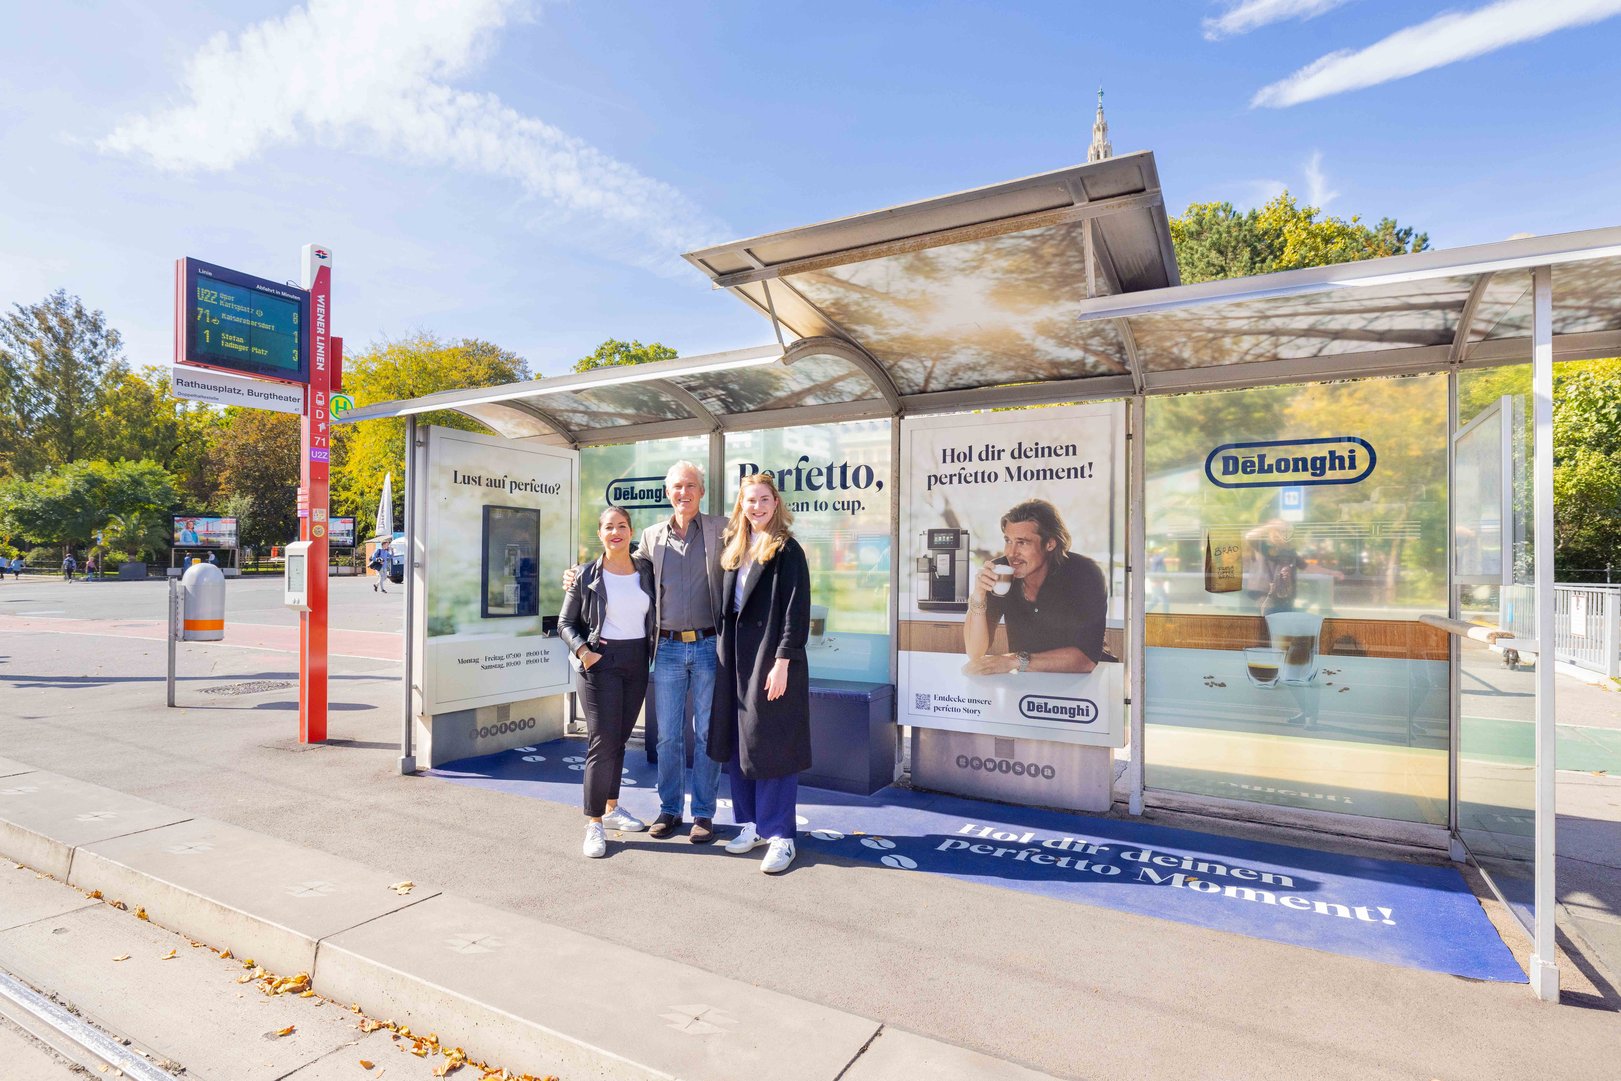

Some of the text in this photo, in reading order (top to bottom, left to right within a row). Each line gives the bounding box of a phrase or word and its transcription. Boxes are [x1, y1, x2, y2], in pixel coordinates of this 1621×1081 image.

[198, 268, 213, 277] Linie
[256, 284, 275, 294] Abfahrt
[281, 290, 301, 300] Minuten
[197, 307, 210, 323] 71
[203, 329, 210, 343] 1
[316, 294, 326, 371] WIENER LINIEN
[292, 349, 299, 362] 3
[176, 378, 301, 404] Rathausplatz, Burgtheater
[315, 409, 325, 419] D
[314, 436, 326, 447] 71
[941, 441, 1077, 464] Hol dir deinen
[453, 470, 561, 495] Lust auf perfetto?
[927, 462, 1094, 491] perfetto Moment!
[784, 499, 866, 515] ean to cup.
[457, 657, 480, 665] Montag
[484, 654, 506, 662] Freitag,
[480, 662, 506, 671] Samstag,
[505, 660, 522, 668] 10:00
[933, 693, 992, 706] Entdecke unsere
[933, 704, 982, 717] perfetto Story
[955, 754, 1056, 780] gewista
[956, 823, 1296, 888] Hol dir deinen
[933, 838, 1397, 926] perfetto Moment!
